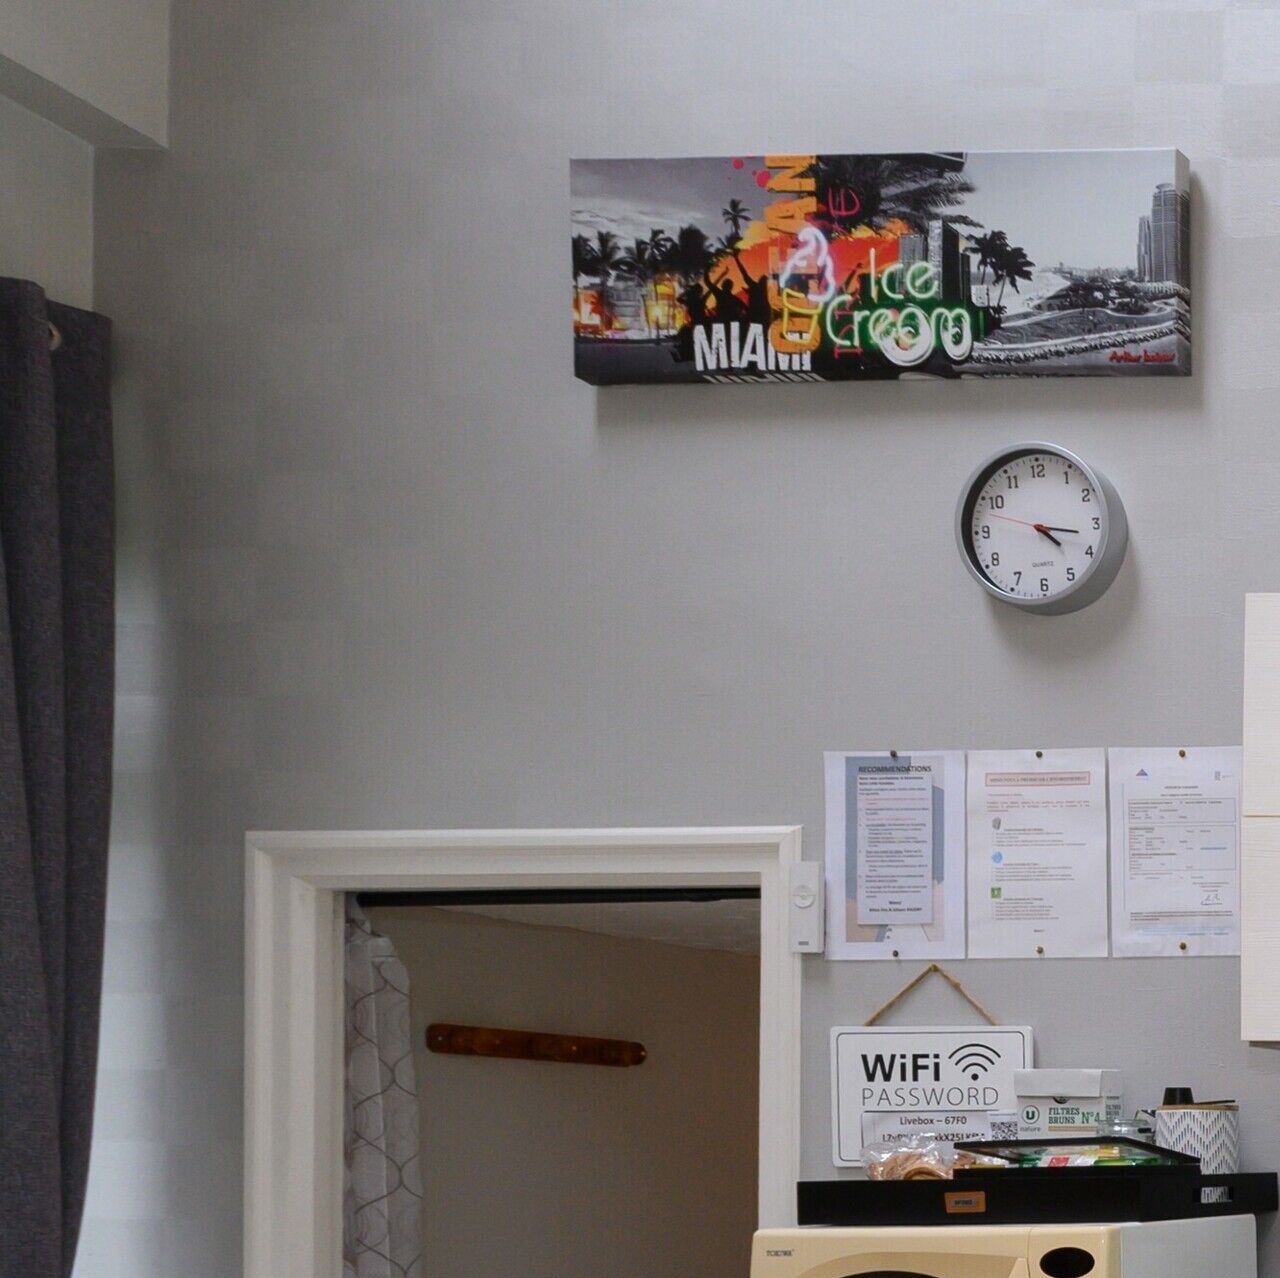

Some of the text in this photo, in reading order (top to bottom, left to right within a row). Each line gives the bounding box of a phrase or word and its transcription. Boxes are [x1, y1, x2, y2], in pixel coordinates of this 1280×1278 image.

[869, 247, 939, 304] Ice
[1030, 464, 1045, 478] 12
[1063, 471, 1069, 484] 1
[1007, 475, 1019, 489] 11
[1082, 488, 1091, 502] 2
[989, 495, 1004, 510] 10
[1092, 517, 1100, 530] 3
[982, 526, 990, 539] 9
[1085, 545, 1094, 558] 4
[991, 552, 1000, 566] 8
[1013, 571, 1022, 586] 7
[1066, 567, 1075, 582] 5
[1040, 578, 1049, 592] 6
[861, 1053, 941, 1082] WiFi
[862, 1087, 999, 1107] PASSWORD
[1048, 1107, 1080, 1116] FILTRES
[1081, 1111, 1100, 1124] N°4
[900, 1116, 934, 1125] Livebox
[1048, 1116, 1075, 1125] BRUNS
